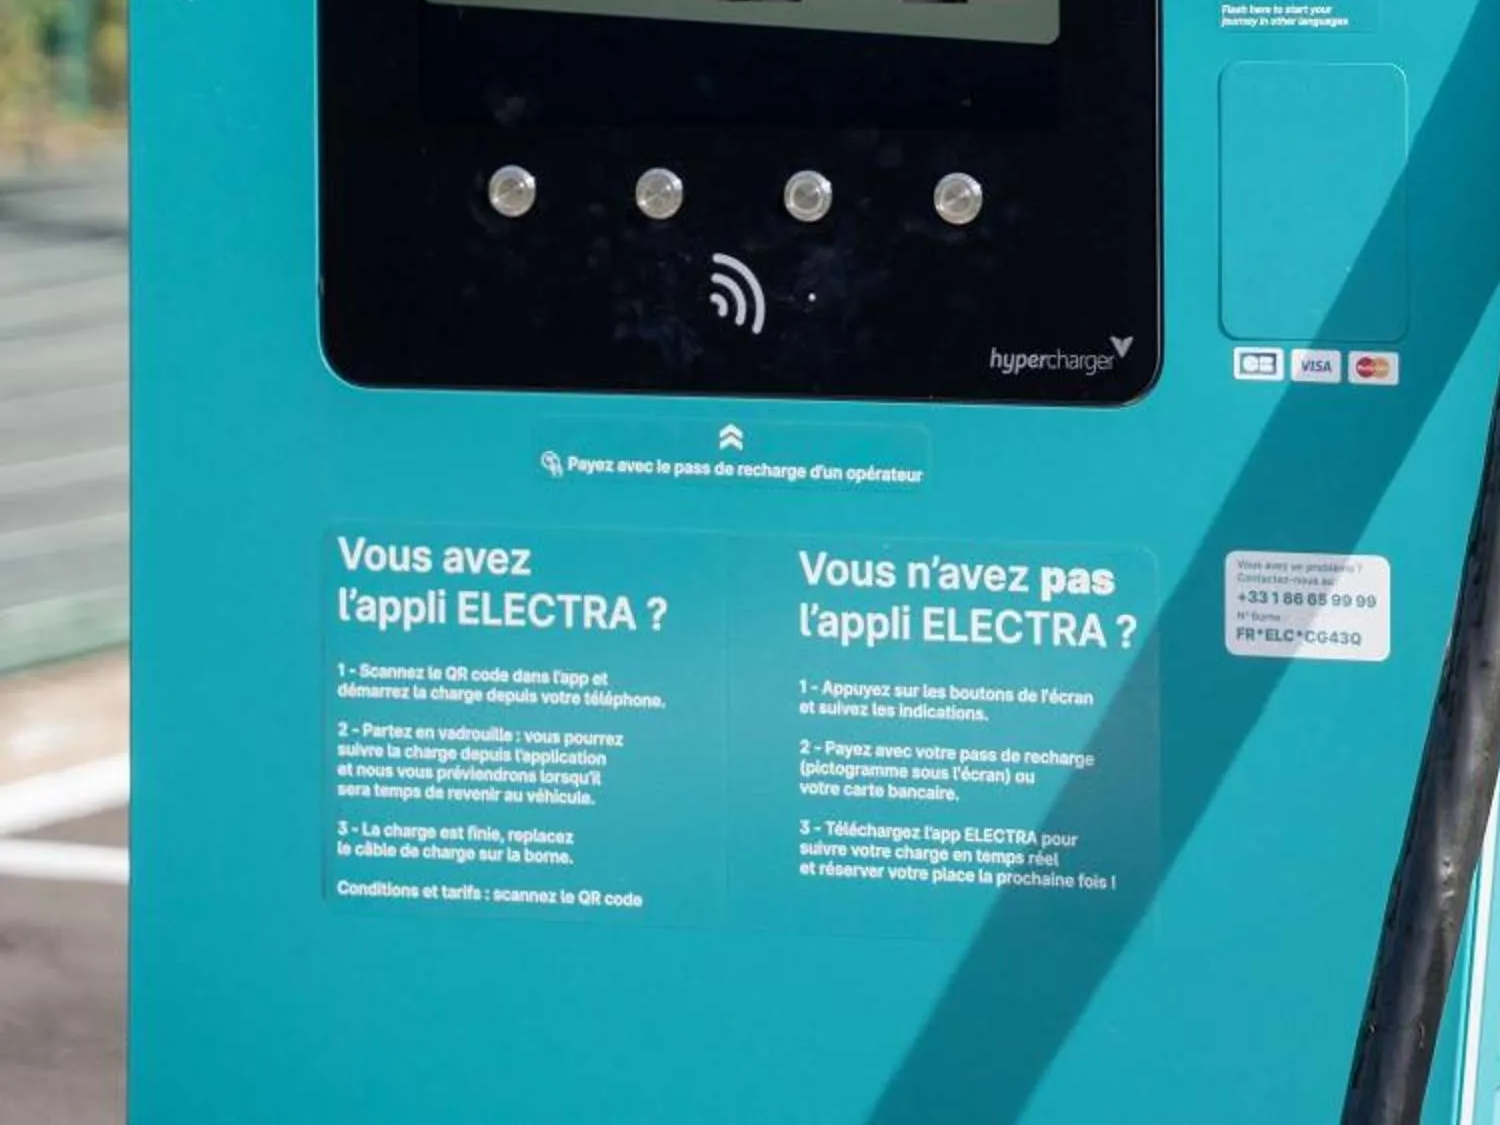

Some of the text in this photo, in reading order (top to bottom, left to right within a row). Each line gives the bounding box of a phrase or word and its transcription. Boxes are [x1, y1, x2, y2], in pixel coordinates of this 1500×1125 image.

[1301, 360, 1332, 372] VISA
[568, 455, 614, 476] Payez
[618, 460, 652, 474] avec
[656, 459, 670, 474] le
[674, 463, 711, 479] pass
[714, 461, 733, 477] de
[737, 463, 806, 480] recharge
[848, 465, 922, 483] opérateur
[337, 537, 532, 575] Vous avez
[799, 550, 1115, 602] Vous n'avez pas
[458, 592, 637, 630] ELECTRA
[647, 597, 668, 631] ?
[923, 607, 1107, 647] ELECTRA
[1116, 615, 1137, 648] ?
[360, 664, 424, 680] Scannez
[428, 667, 442, 680] le
[445, 668, 468, 681] QR
[472, 669, 508, 682] code
[513, 670, 548, 684] dans
[593, 672, 608, 685] et
[338, 683, 665, 710] démarrez la charge depuis votre téléphone.
[822, 680, 890, 700] Appuyez
[894, 686, 919, 698] sur
[923, 684, 945, 699] les
[950, 685, 1014, 702] boutons
[1018, 687, 1037, 702] de
[800, 701, 988, 721] et suivez les indications.
[364, 724, 623, 747] Partez en vadrouille vous pourrez
[338, 743, 383, 758] suivre
[387, 744, 401, 758] la
[405, 745, 456, 764] charge
[460, 747, 511, 765] depuis
[825, 742, 1095, 767] Payez avec votre pass de recharge
[338, 764, 353, 777] et
[356, 766, 393, 778] nous
[397, 767, 433, 779] vous
[437, 766, 536, 785] préviendrons
[800, 760, 908, 779] (pictogramme
[912, 768, 949, 779] sous
[1016, 771, 1035, 783] ou
[338, 785, 595, 805] sera temps de revenir au véhicule.
[800, 782, 959, 801] votre carte bancaire.
[363, 822, 573, 846] La charge est finie, replacez
[826, 821, 922, 840] Téléchargez
[965, 827, 1036, 844] ELECTRA
[1041, 832, 1077, 848] pour
[338, 842, 573, 864] le câble de charge sur la borne.
[800, 841, 1058, 866] suivre votre charge en temps réel
[800, 863, 1106, 889] et réserver votre place la prochaine fois
[338, 880, 643, 907] Conditions et tarifs scannez le QR code
